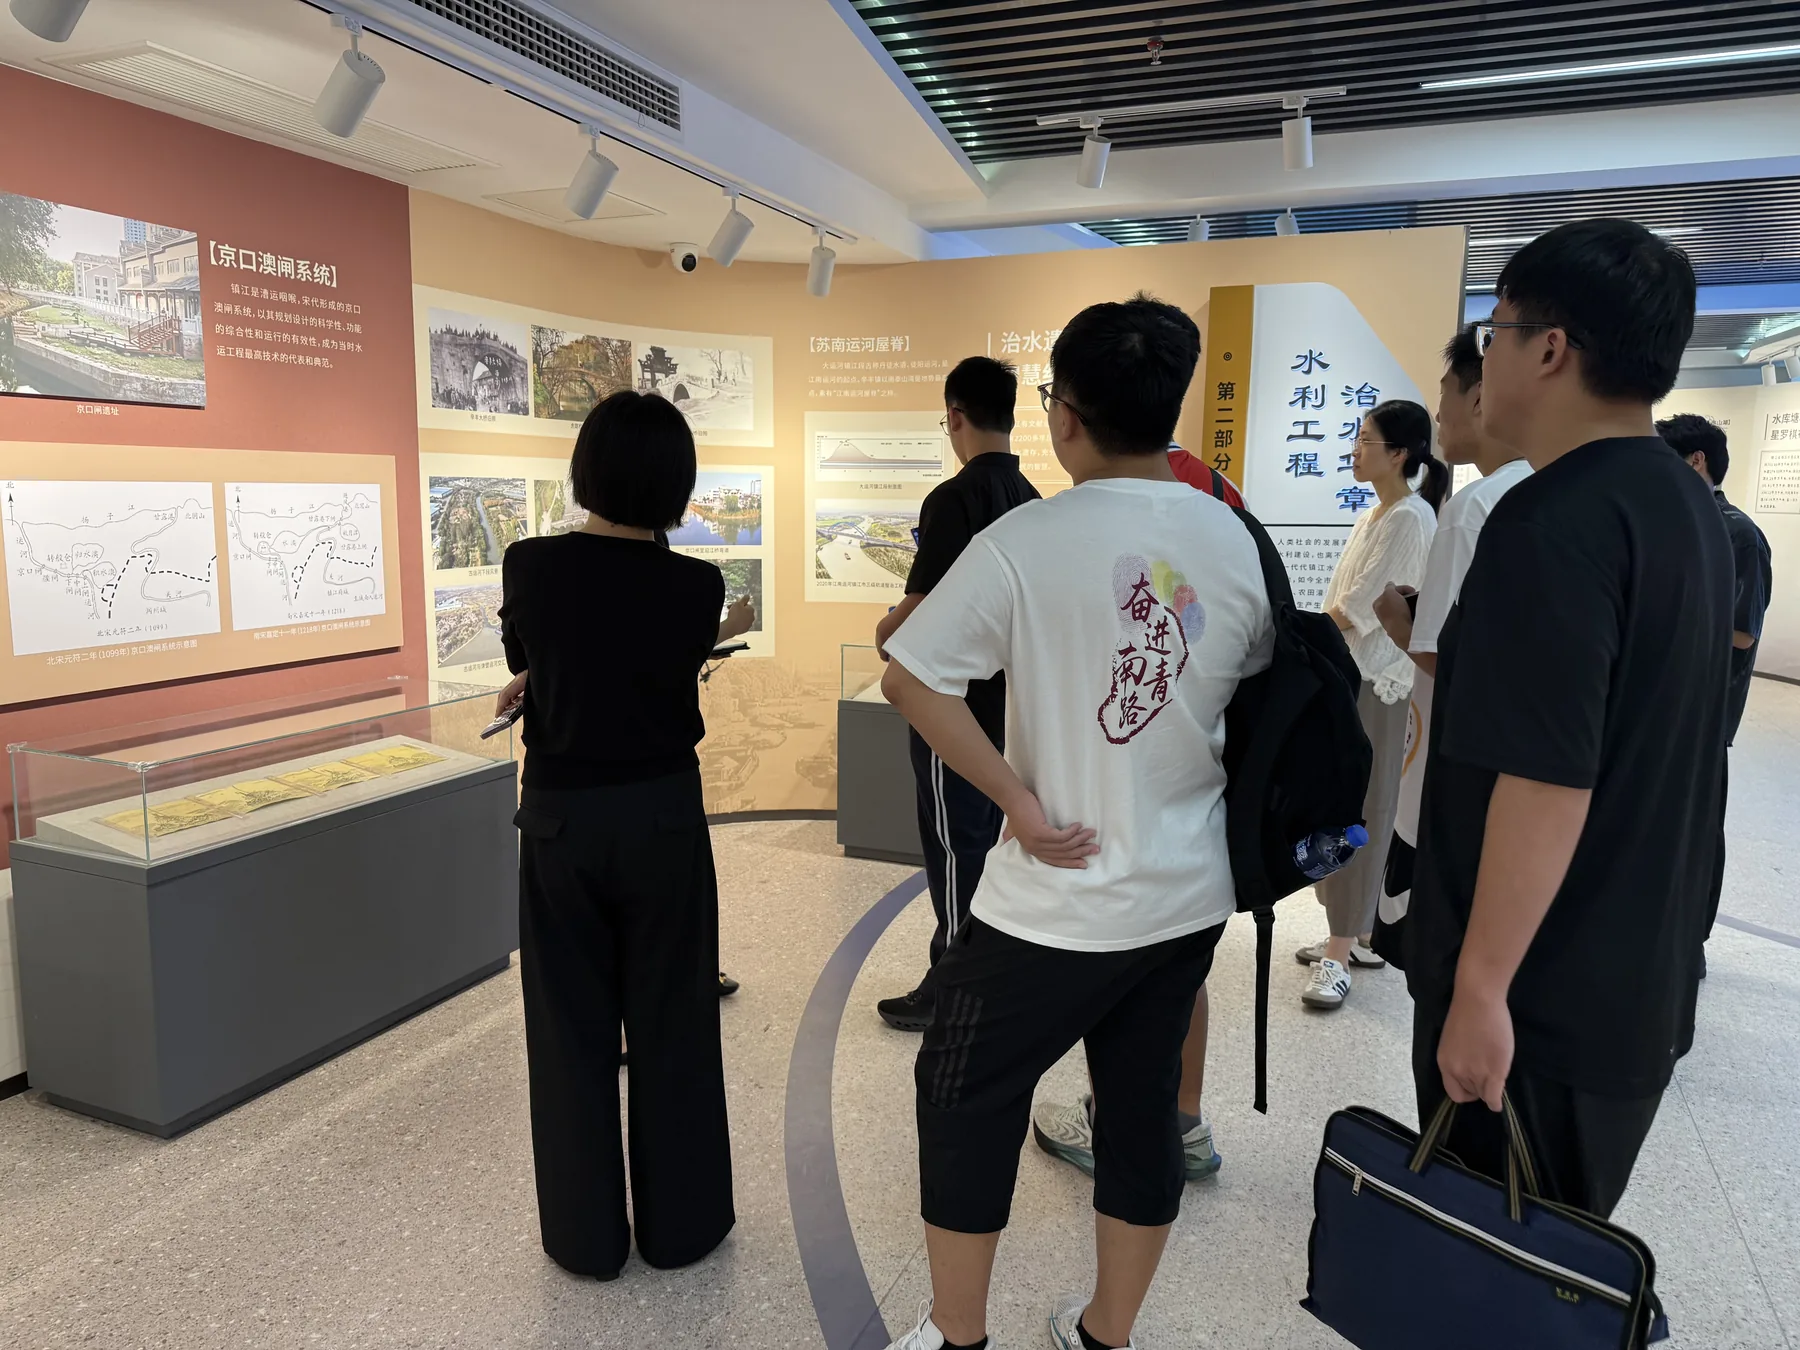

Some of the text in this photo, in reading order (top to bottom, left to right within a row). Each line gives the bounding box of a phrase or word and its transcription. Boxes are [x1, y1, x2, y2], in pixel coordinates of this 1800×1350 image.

[209, 240, 337, 288] 【京口澳闸系统】
[809, 336, 911, 353] 【苏南运河屋脊】
[76, 404, 119, 416] 京口闸遗址
[1213, 381, 1236, 471] 第二部分
[1286, 348, 1331, 478] 水利工程
[1770, 429, 1800, 441] 星罗棋
